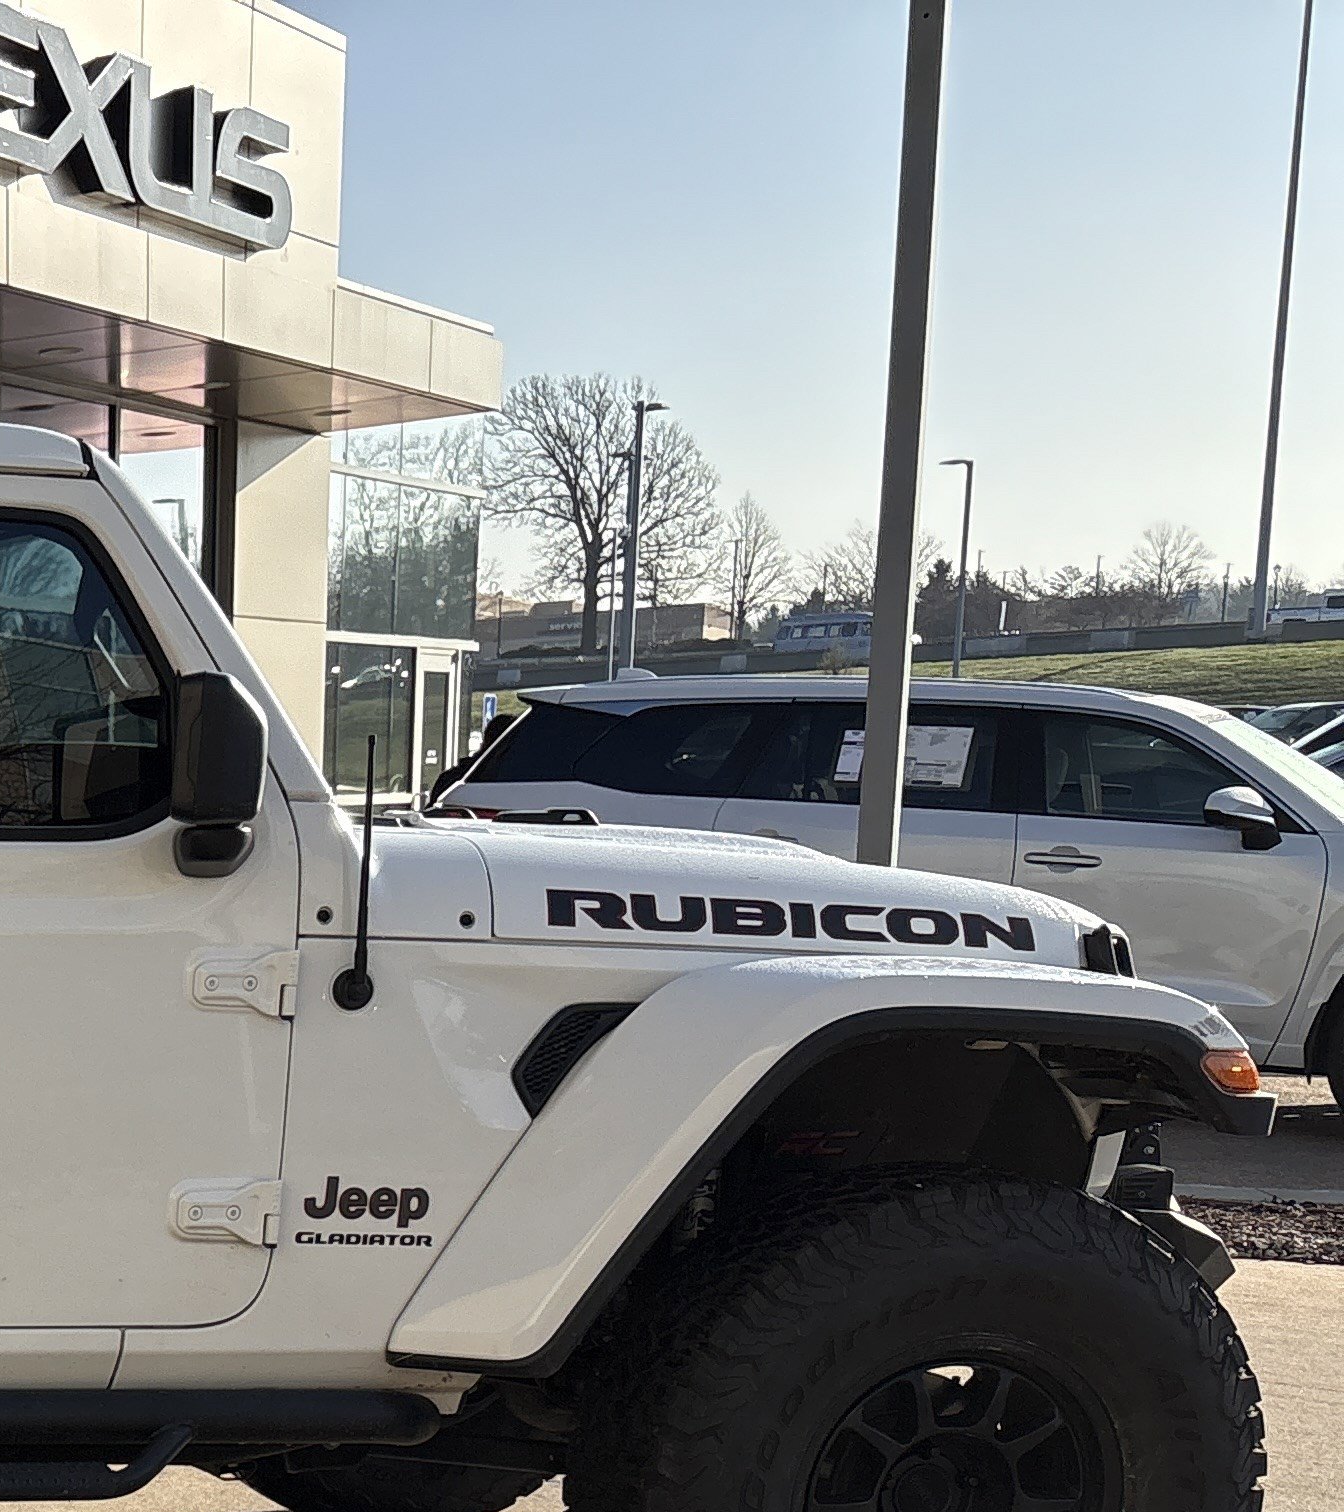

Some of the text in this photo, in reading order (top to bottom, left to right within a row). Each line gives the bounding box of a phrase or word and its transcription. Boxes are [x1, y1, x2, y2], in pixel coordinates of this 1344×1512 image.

[546, 888, 1036, 952] RUBICON
[304, 1176, 430, 1228] Jeep
[295, 1231, 433, 1247] GLADIATOR
